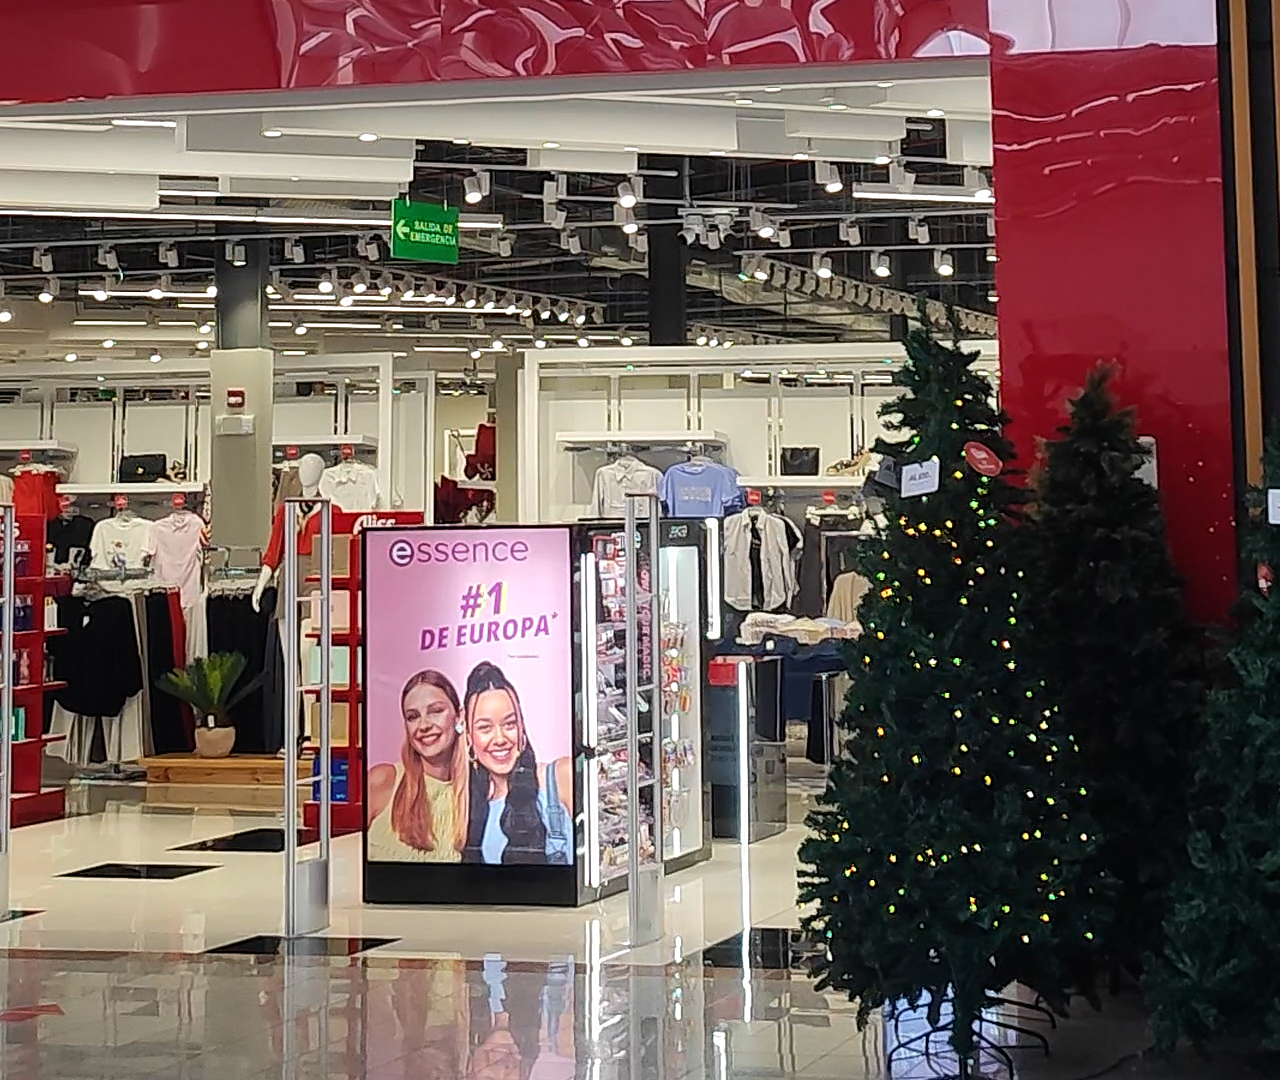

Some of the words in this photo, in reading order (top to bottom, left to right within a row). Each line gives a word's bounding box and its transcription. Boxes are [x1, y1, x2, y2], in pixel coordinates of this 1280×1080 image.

[410, 231, 456, 245] EMERGENCIA
[414, 220, 441, 233] SALIDA
[443, 223, 453, 234] DE
[389, 539, 529, 567] essence
[460, 581, 506, 619] #1
[420, 626, 449, 651] DE
